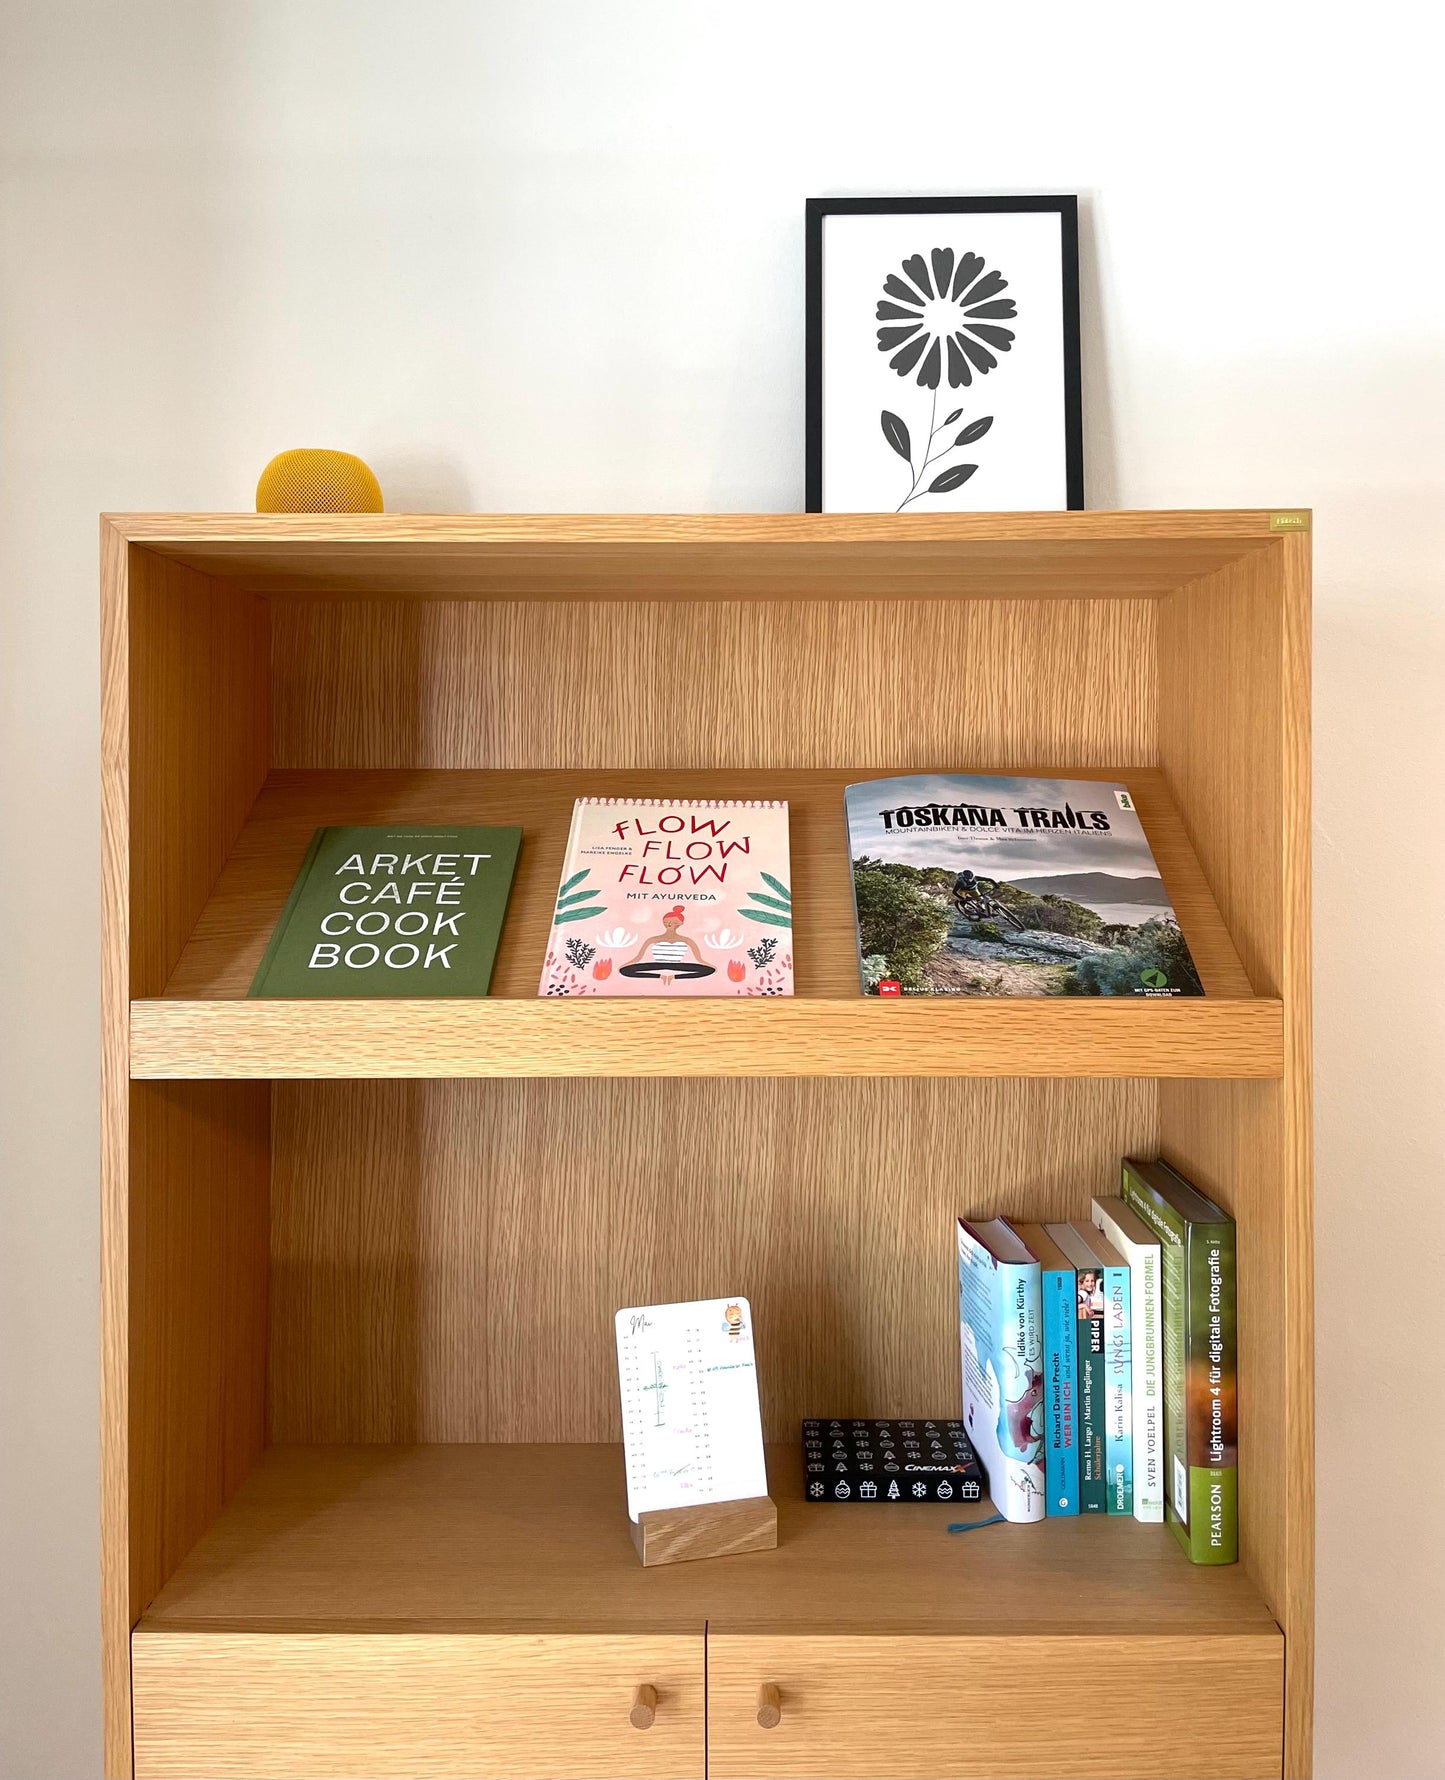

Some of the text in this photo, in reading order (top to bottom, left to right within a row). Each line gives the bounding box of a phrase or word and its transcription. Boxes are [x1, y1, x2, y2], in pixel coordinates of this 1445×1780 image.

[612, 815, 730, 840] FLOW
[878, 802, 1110, 831] TOSKANA TRAILS
[885, 826, 959, 834] MOUNTAINBIKEN
[642, 836, 751, 861] FLOW
[335, 853, 492, 876] ARKET
[339, 876, 466, 905] CAFÉ
[626, 892, 716, 901] MIT AYURVEDA
[320, 912, 466, 936] COOK
[308, 942, 458, 969] BOOK
[1016, 1278, 1026, 1309] Kürthy
[1208, 1249, 1222, 1312] Fotografie
[1112, 1286, 1123, 1328] LADEN
[1091, 1320, 1100, 1352] PIPER
[1144, 1254, 1156, 1396] DIE JUNGBRUNNEN-FORMEL
[1016, 1332, 1026, 1357] Ildikó
[1029, 1347, 1035, 1356] ES
[1208, 1316, 1223, 1362] digitale
[1112, 1334, 1124, 1374] SUNGS
[1063, 1365, 1071, 1378] und
[1084, 1360, 1093, 1394] Beglinger
[1209, 1366, 1221, 1384] für
[1063, 1382, 1071, 1400] ICH
[1212, 1387, 1220, 1396] 4
[1063, 1403, 1071, 1421] BIN
[1114, 1384, 1124, 1442] Karin Kalisa
[1052, 1414, 1061, 1448] Richard
[1064, 1424, 1072, 1448] WER
[1084, 1427, 1093, 1447] Largo
[1210, 1399, 1224, 1461] Lightroom
[1084, 1449, 1091, 1458] H.
[1147, 1406, 1156, 1487] SVEN VOELPEL
[1116, 1472, 1124, 1510] DROEMER
[1210, 1485, 1222, 1546] PEARSON
